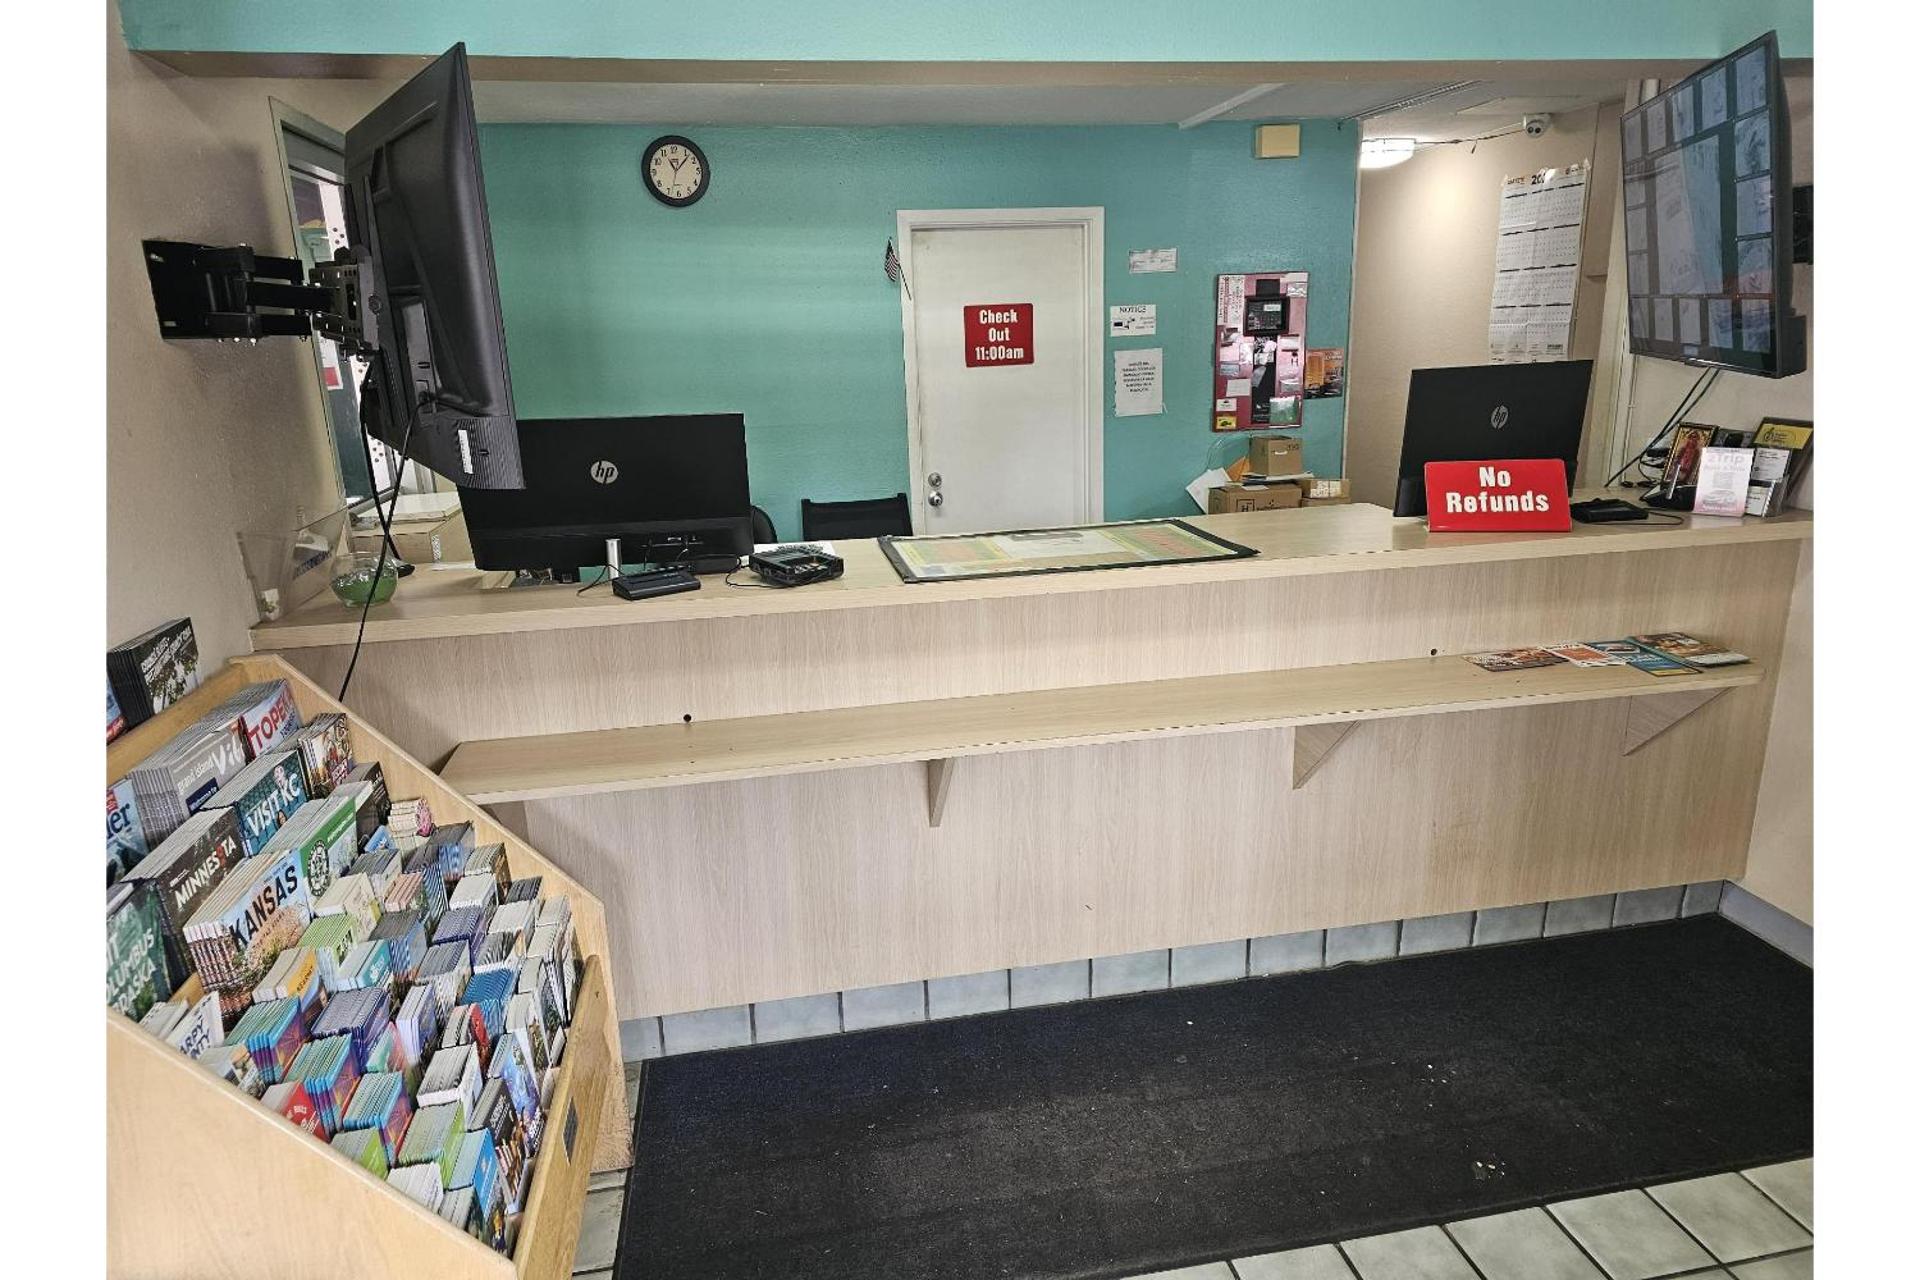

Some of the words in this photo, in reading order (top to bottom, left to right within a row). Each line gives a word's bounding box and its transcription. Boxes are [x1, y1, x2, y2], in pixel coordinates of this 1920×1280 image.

[979, 309, 1018, 324] Check
[988, 327, 1010, 342] Out
[975, 345, 1024, 360] 11:00am
[1491, 405, 1509, 429] hp
[592, 460, 617, 485] hp
[1479, 466, 1511, 487] No
[1446, 491, 1549, 513] Refunds
[246, 789, 281, 836] VISIT
[275, 768, 301, 807] KC
[229, 864, 298, 947] KANSAS
